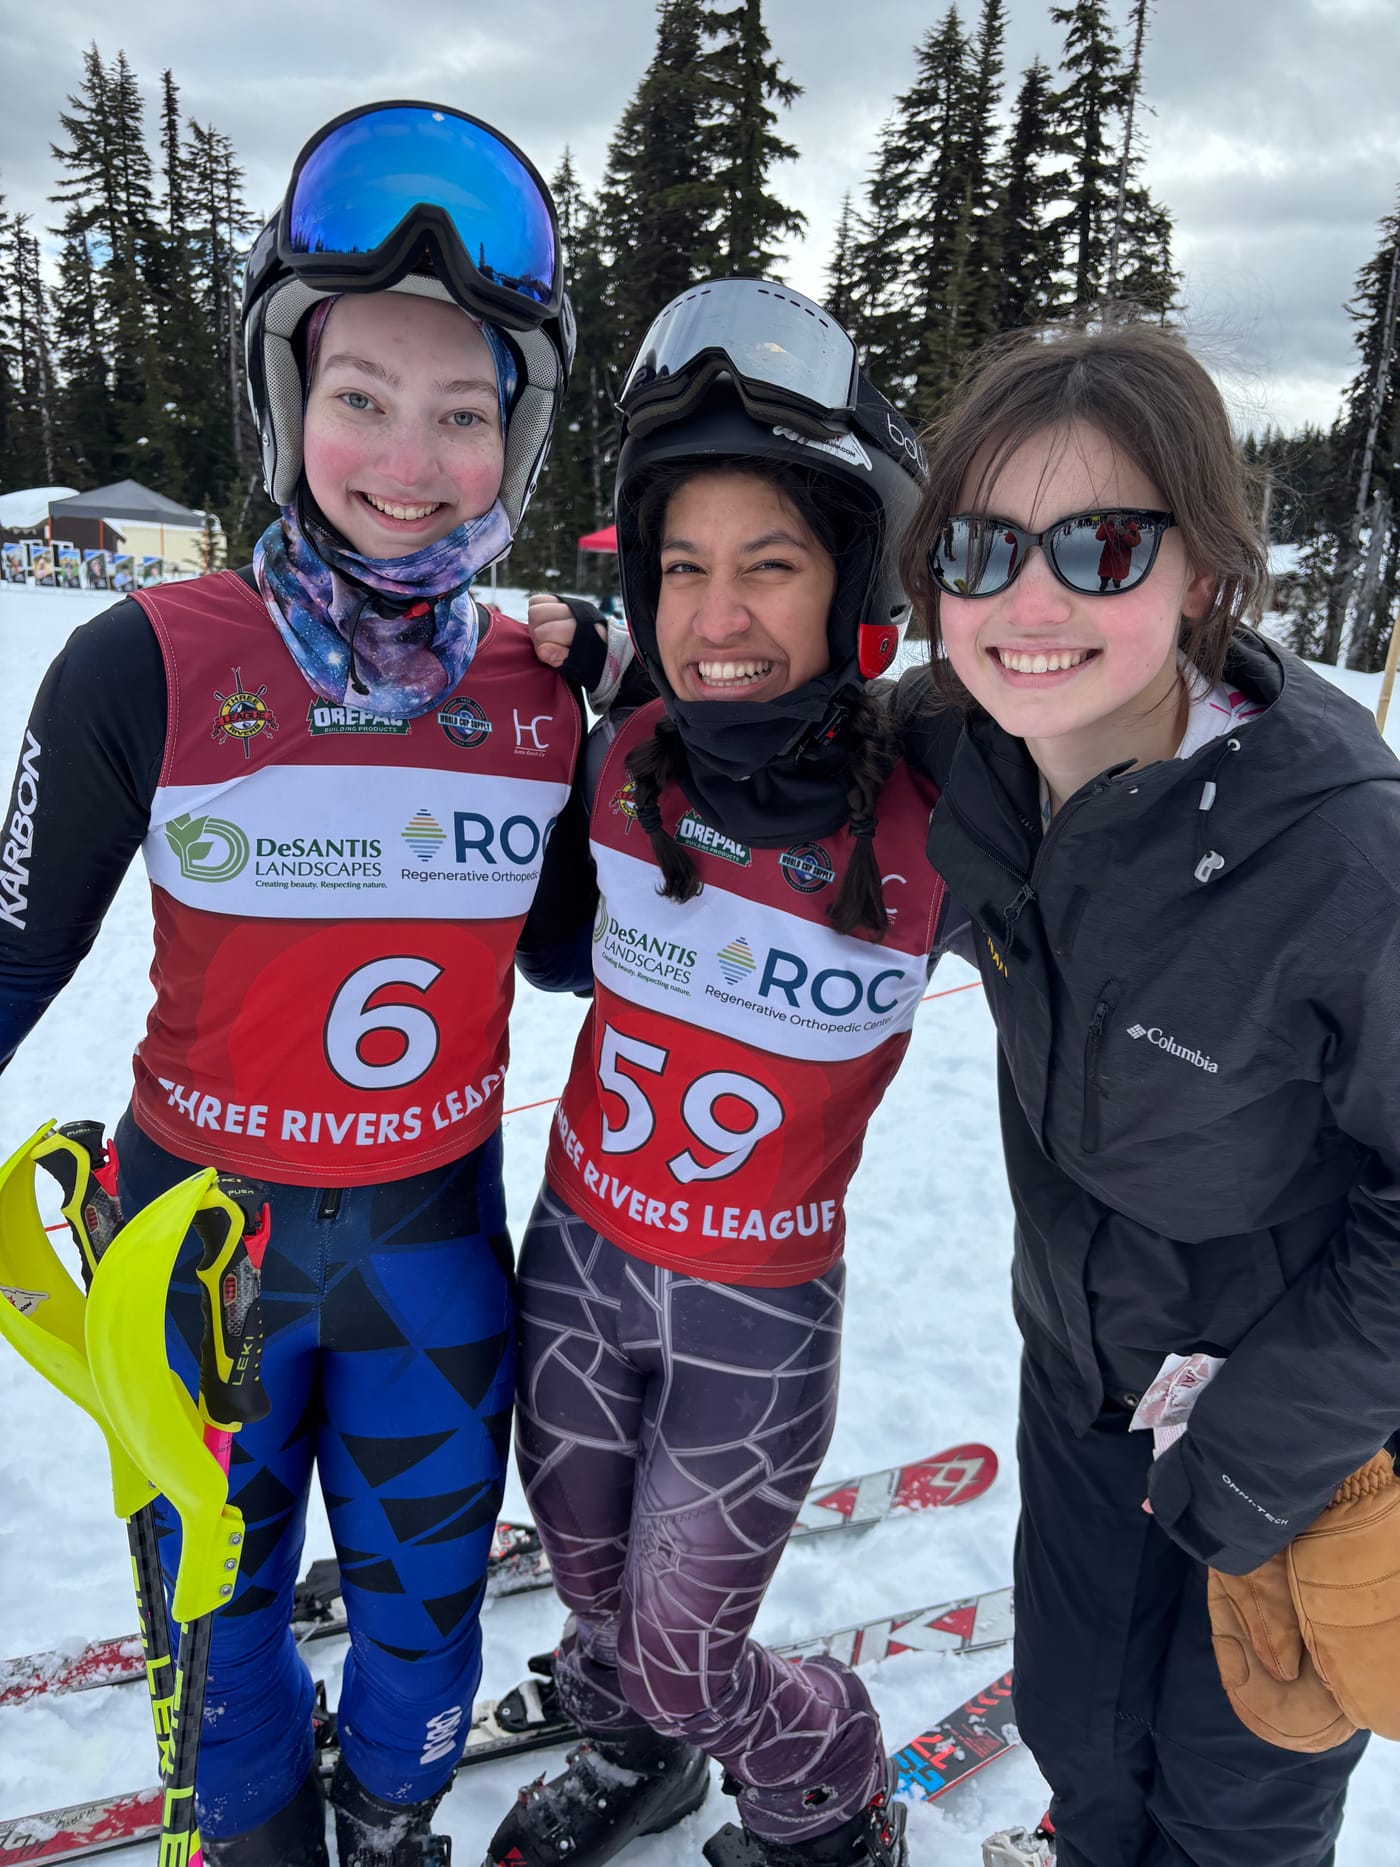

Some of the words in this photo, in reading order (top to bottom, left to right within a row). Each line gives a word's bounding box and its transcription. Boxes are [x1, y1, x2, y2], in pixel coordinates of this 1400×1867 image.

[0, 728, 42, 931] KARBON
[256, 838, 382, 858] DeSANTIS
[255, 861, 382, 877] LANDSCAPES
[255, 880, 289, 889] Creating
[290, 880, 319, 890] beauty.
[320, 881, 361, 890] Respecting
[401, 868, 489, 883] Regenerative
[781, 854, 801, 868] WORLD
[801, 862, 813, 873] CUP
[812, 866, 833, 881] SUPPLY
[604, 936, 692, 984] LANDSCAPES
[609, 918, 698, 968] DeSANTIS
[637, 972, 669, 990] Respecting
[669, 984, 691, 997] nature.
[757, 947, 907, 1017] ROC
[322, 954, 445, 1091] 6
[704, 984, 787, 1022] Regenerative
[789, 1014, 861, 1034] Orthopedic
[1146, 1028, 1219, 1074] Columbia
[157, 1076, 269, 1138] THREE
[280, 1105, 422, 1146] RIVERS
[431, 1064, 508, 1131] LEAG
[598, 1021, 785, 1185] 59
[555, 1104, 585, 1172] HREE
[583, 1159, 690, 1233] RIVERS
[701, 1199, 836, 1242] LEAGUE
[231, 1335, 255, 1387] LEKI
[1221, 1474, 1289, 1526] OMNI-TECH
